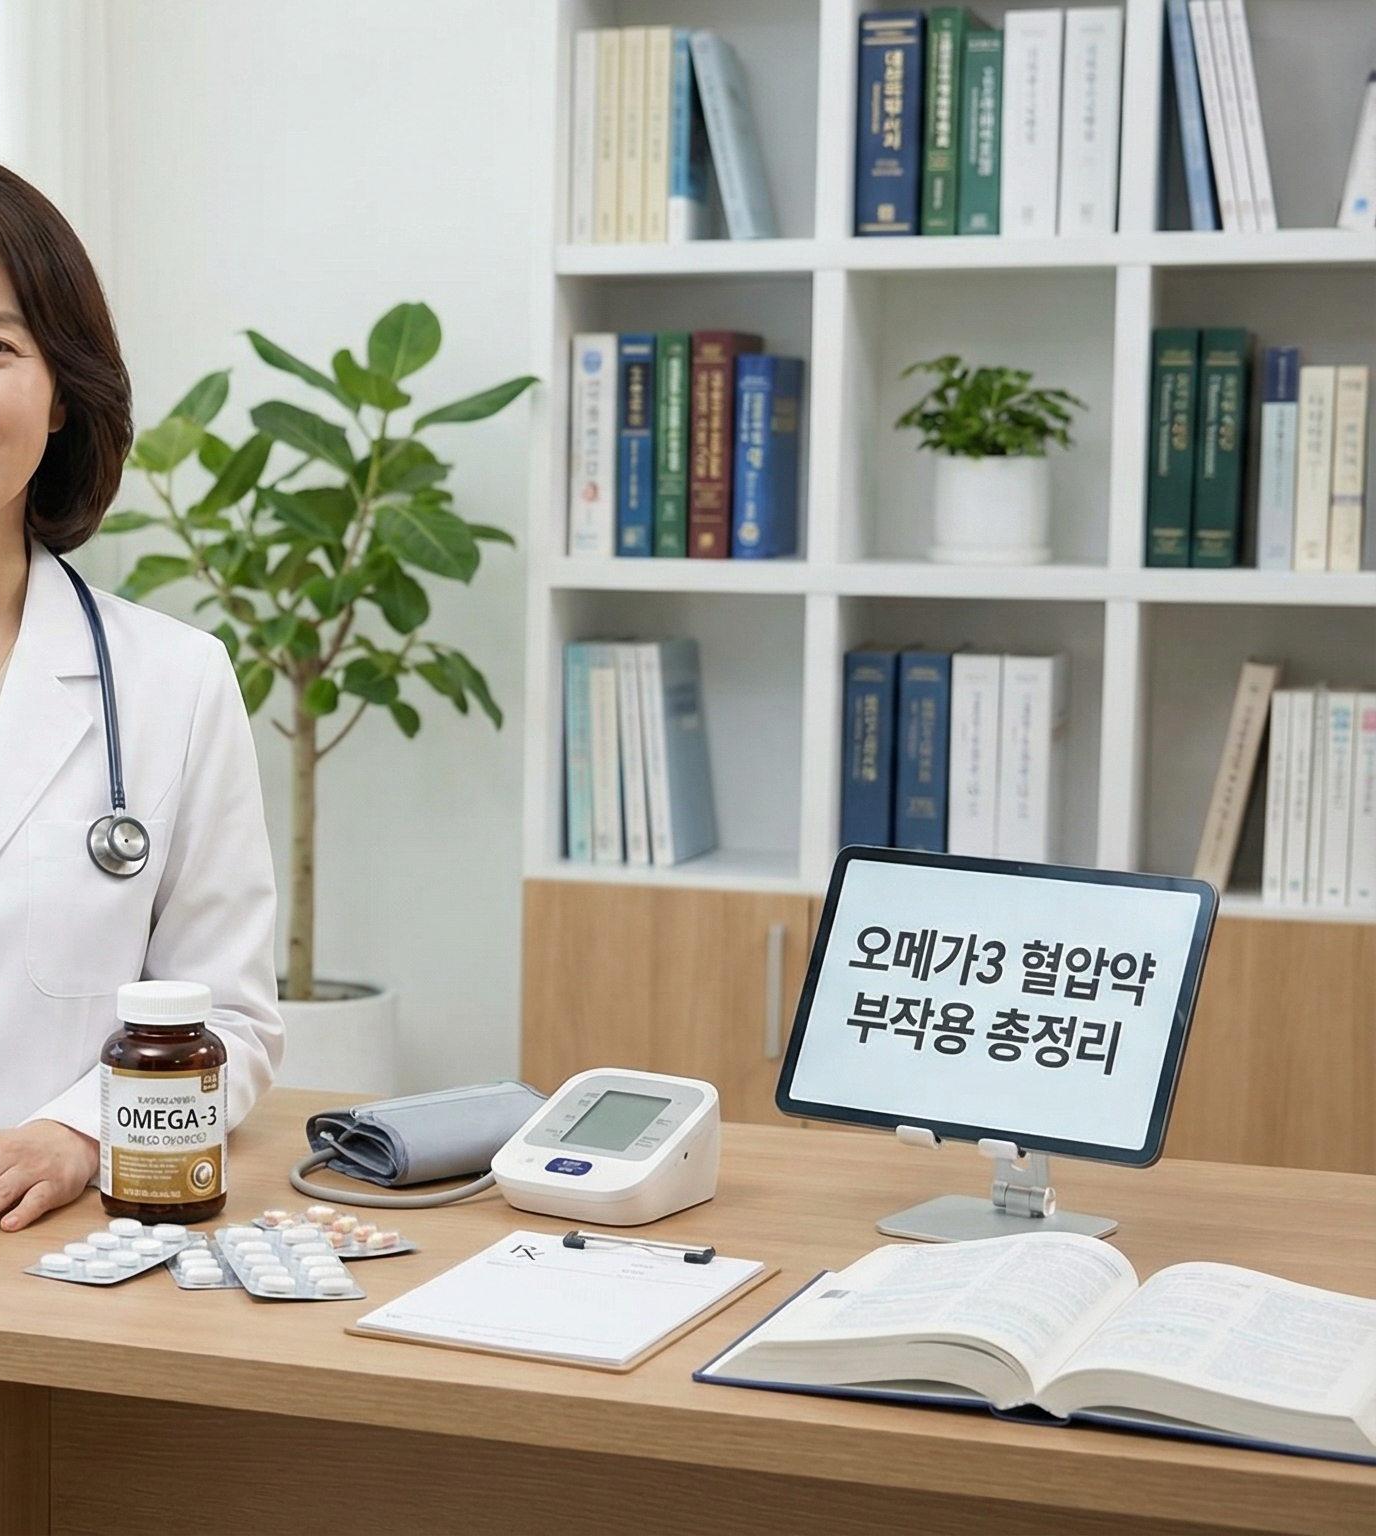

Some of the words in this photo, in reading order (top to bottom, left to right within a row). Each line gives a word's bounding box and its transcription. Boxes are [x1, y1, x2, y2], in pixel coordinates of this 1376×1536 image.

[848, 925, 1007, 986] 오메가3
[1021, 939, 1157, 1007] 혈압약
[846, 992, 975, 1055] 부작용
[986, 1008, 1122, 1076] 총정리
[117, 1105, 217, 1131] OMEGA-3
